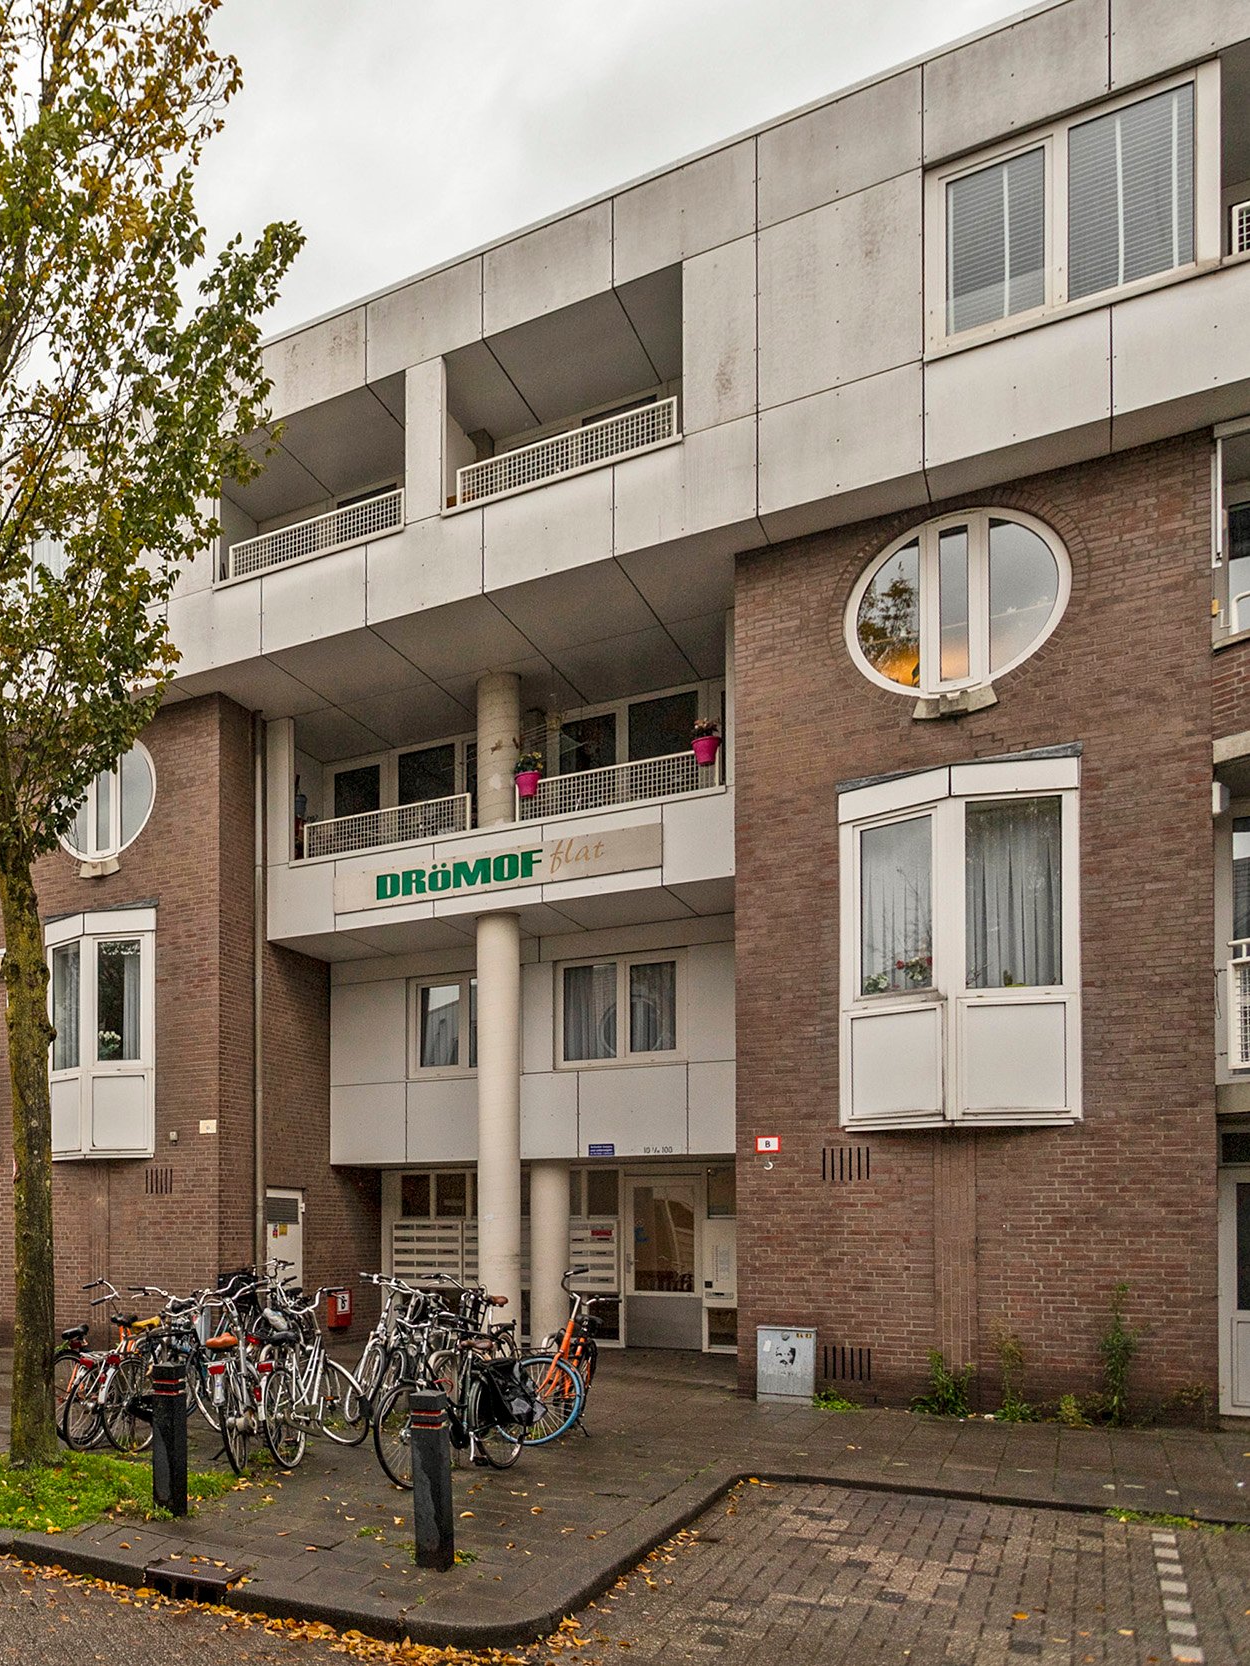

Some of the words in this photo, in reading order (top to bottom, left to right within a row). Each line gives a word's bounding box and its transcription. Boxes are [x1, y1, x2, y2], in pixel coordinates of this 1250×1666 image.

[376, 849, 543, 900] DRöMOF
[550, 838, 605, 874] flat
[661, 1145, 673, 1153] 100
